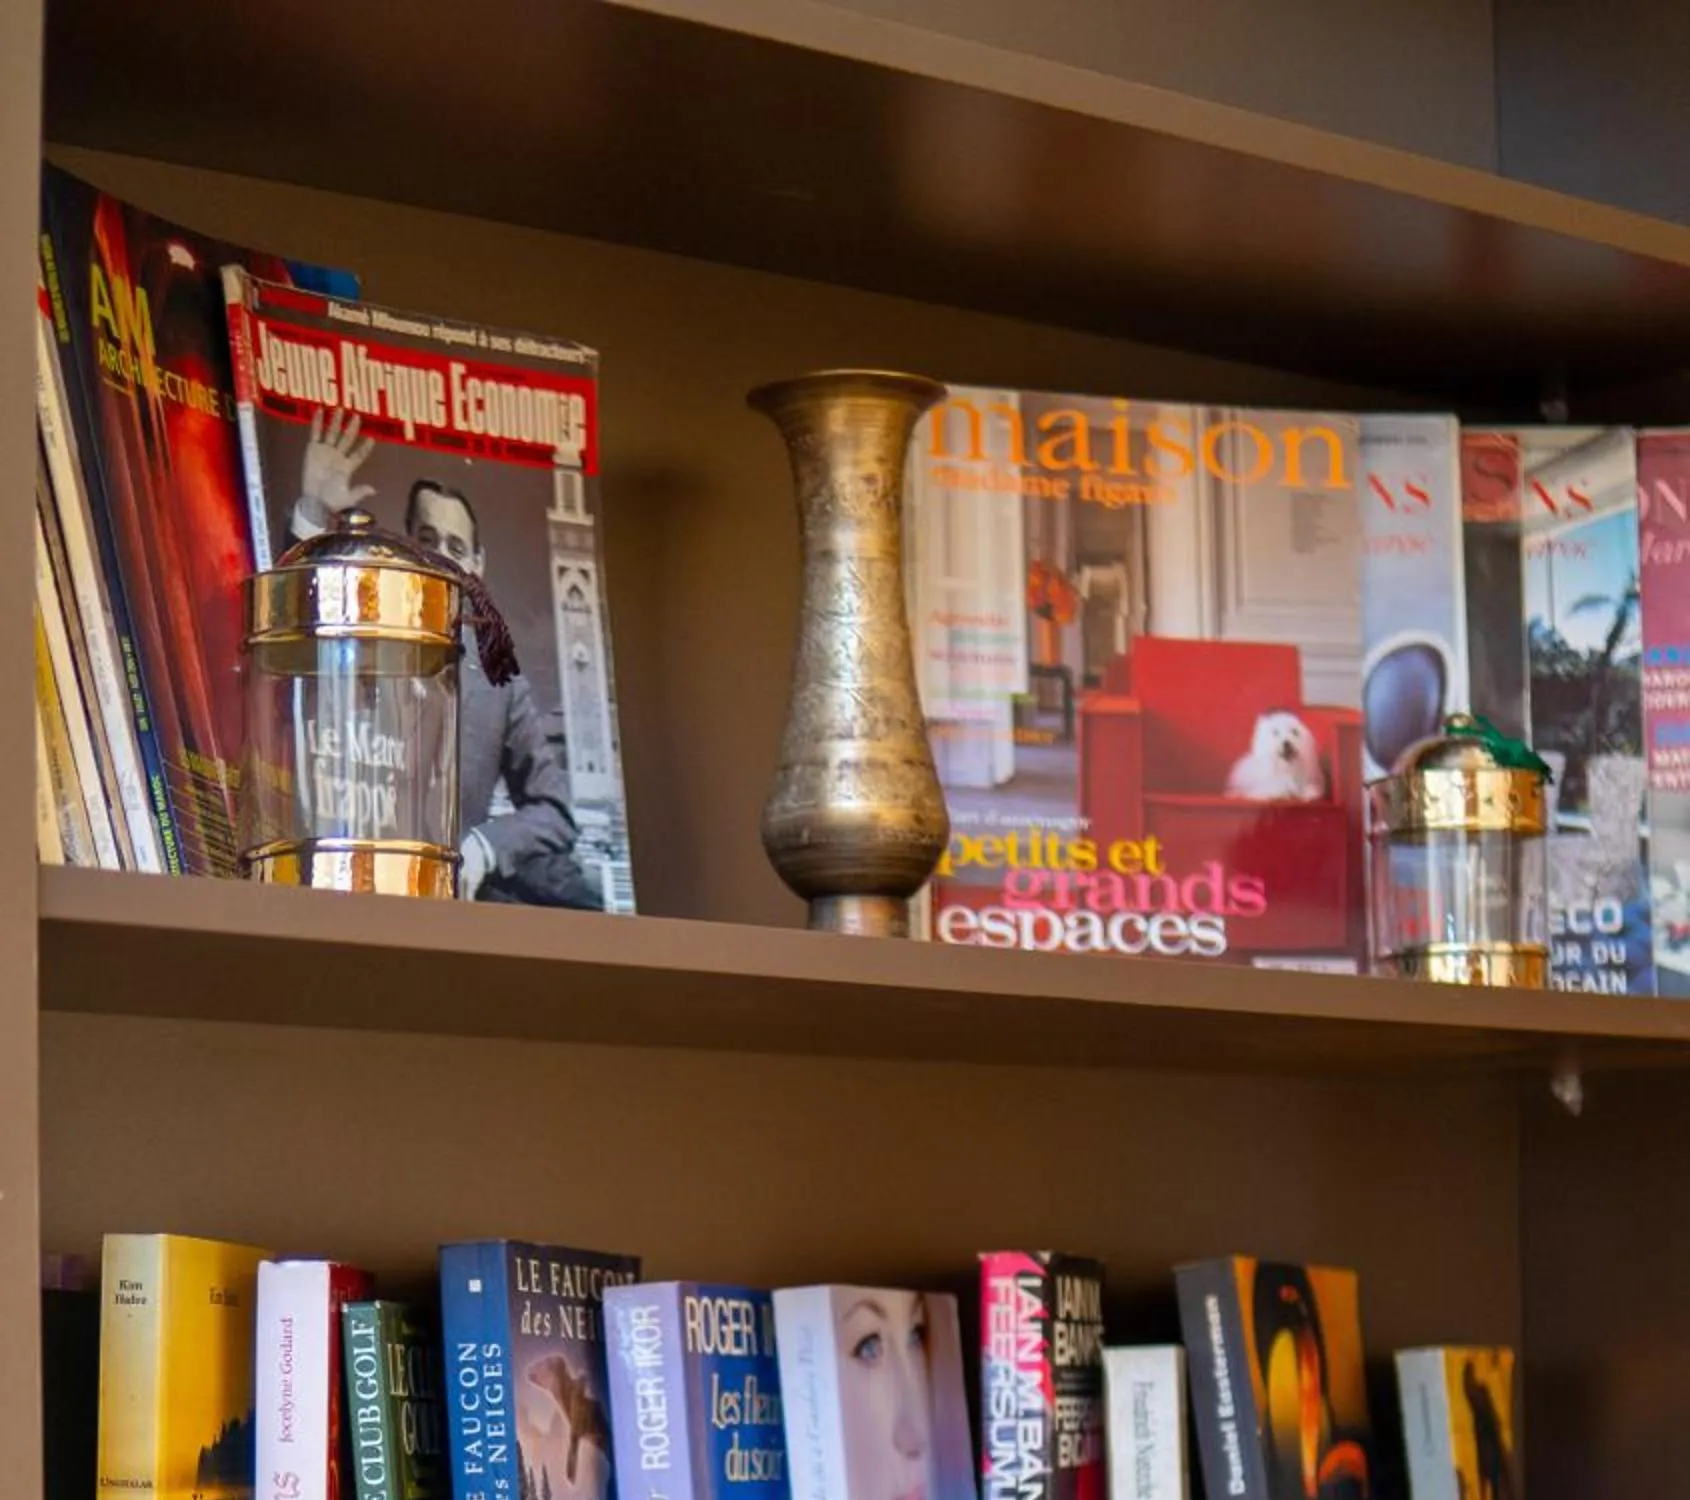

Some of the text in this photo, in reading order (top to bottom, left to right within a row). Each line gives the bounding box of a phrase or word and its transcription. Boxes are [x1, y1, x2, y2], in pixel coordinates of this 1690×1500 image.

[90, 263, 157, 356] AM
[257, 321, 338, 407] Jeune
[340, 341, 446, 441] Afrique
[450, 361, 586, 451] Economie
[928, 396, 1352, 490] maison
[935, 826, 1167, 878] petits et
[1003, 861, 1268, 918] grands
[937, 905, 1228, 957] espaces
[514, 1256, 541, 1293] LE
[520, 1300, 552, 1336] des
[684, 1295, 758, 1356] ROGER
[1018, 1276, 1044, 1362] IAIN
[352, 1318, 379, 1401] GOLF
[631, 1304, 672, 1471] ROGER IKOR
[458, 1342, 484, 1476] FAUCON
[482, 1342, 509, 1463] NEIGES
[711, 1372, 741, 1429] Les
[357, 1405, 386, 1481] CLUB
[1219, 1422, 1247, 1497] Daniel
